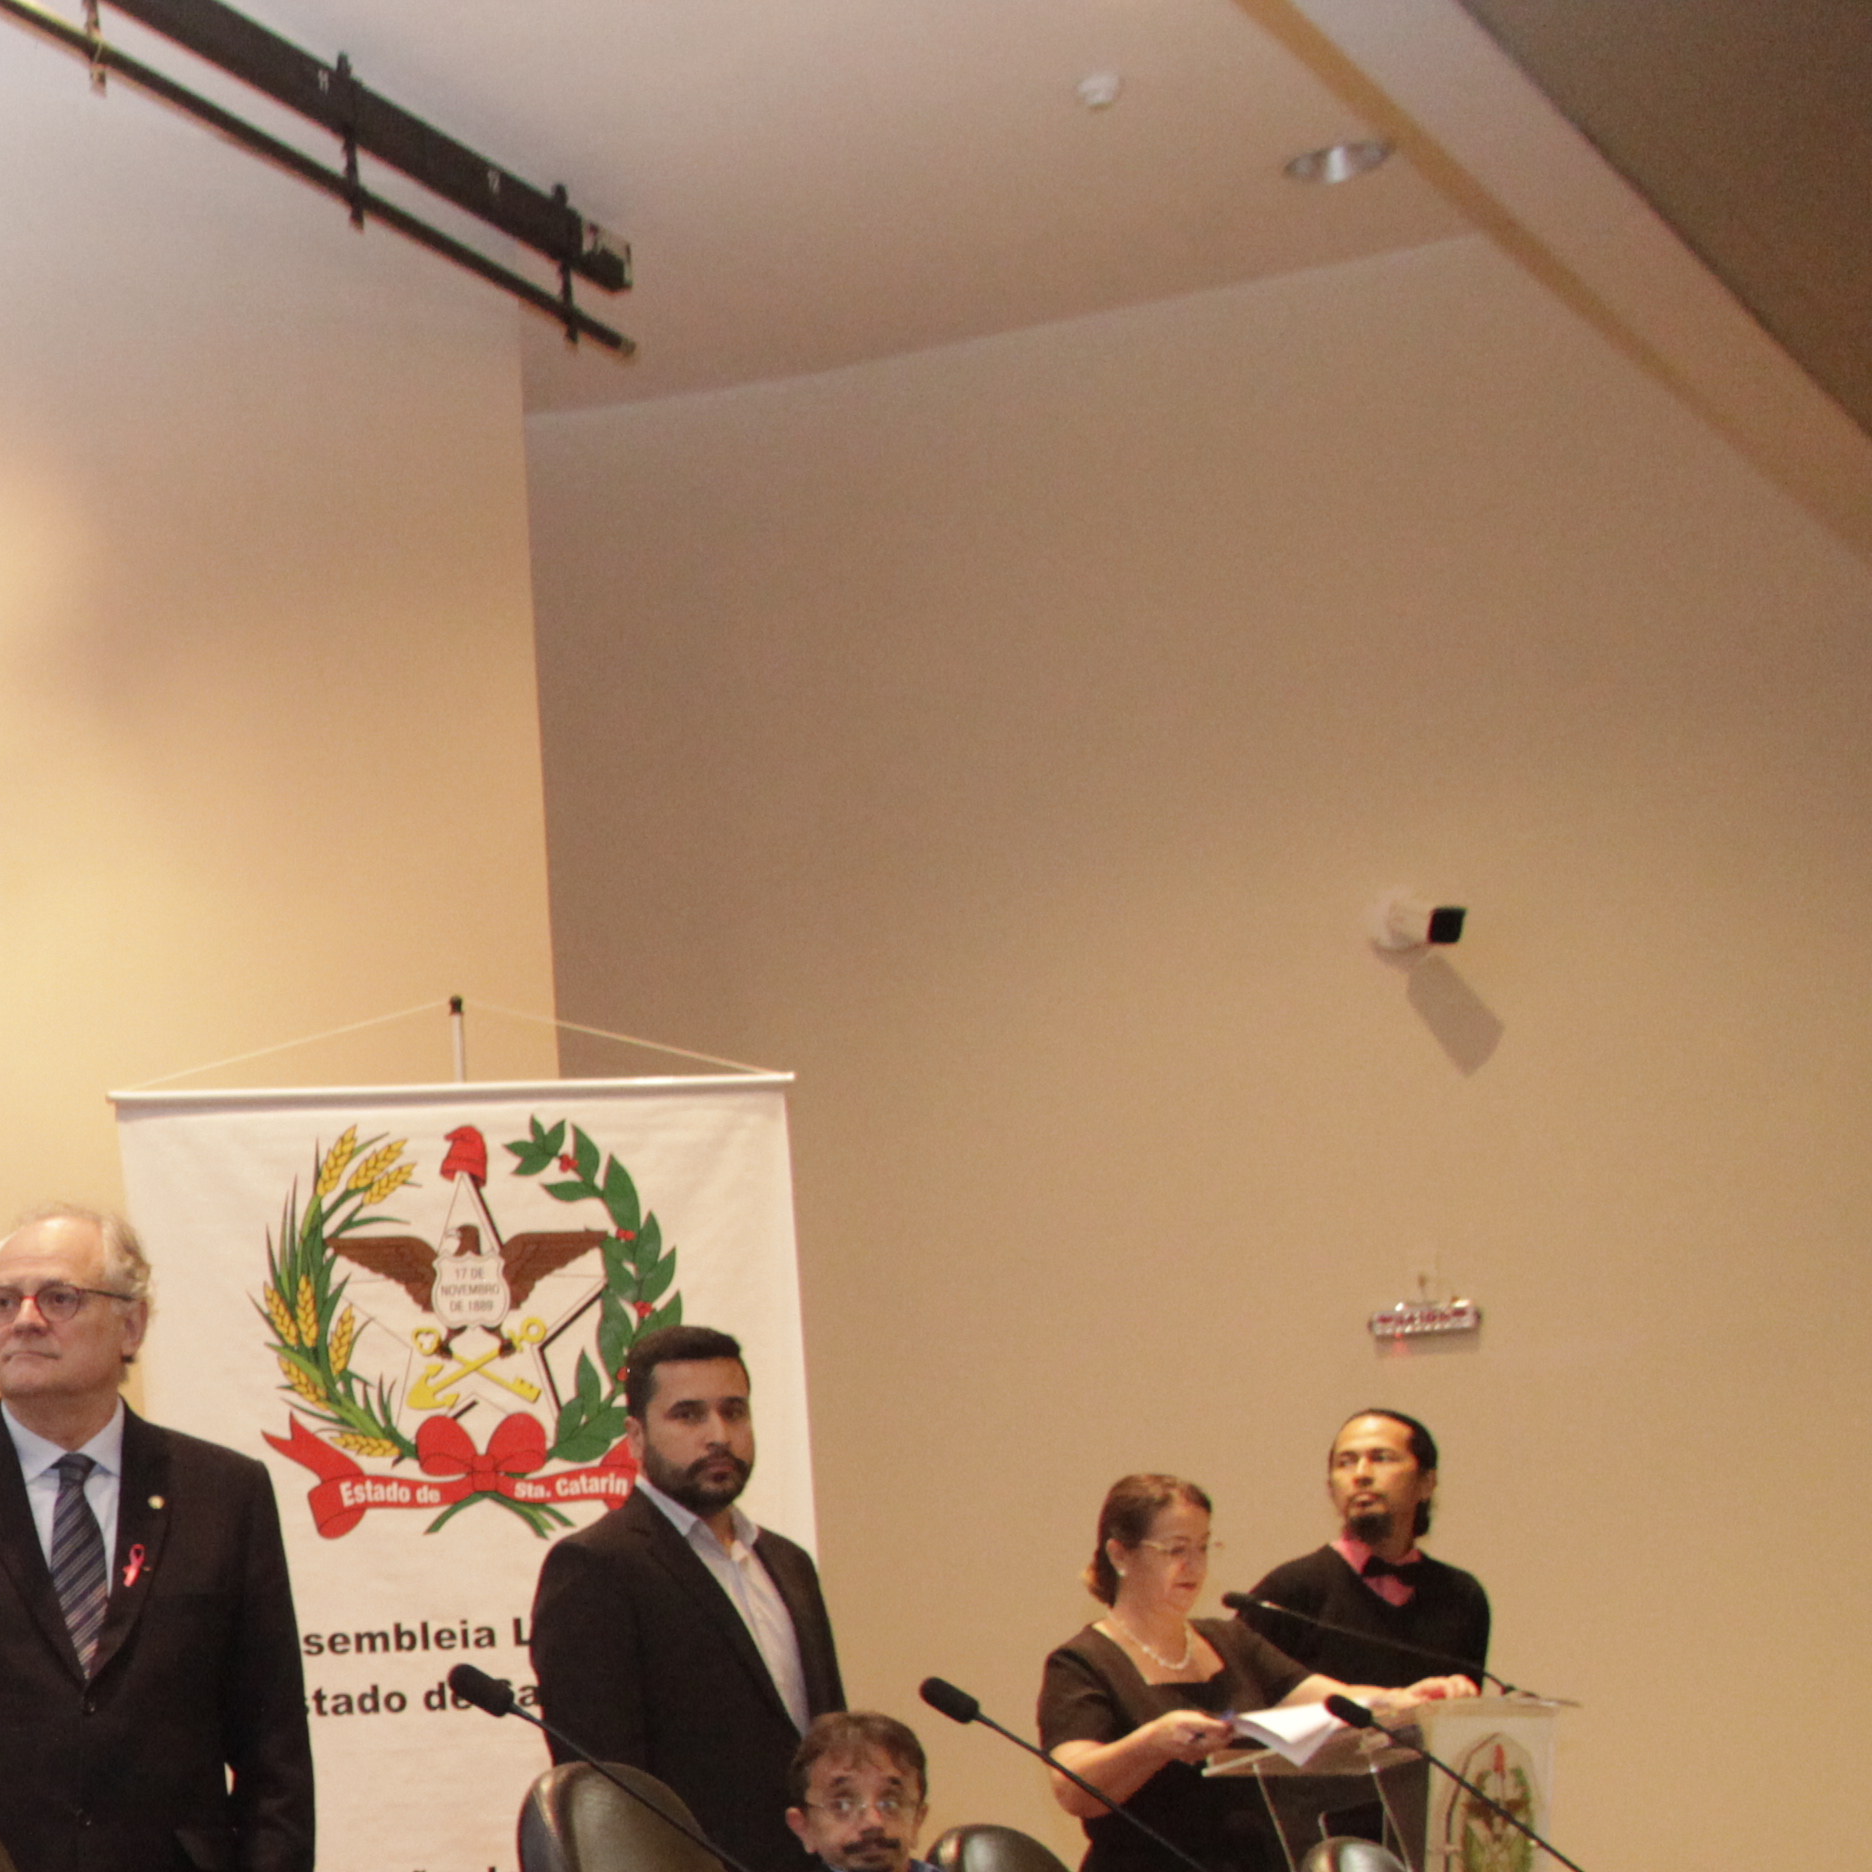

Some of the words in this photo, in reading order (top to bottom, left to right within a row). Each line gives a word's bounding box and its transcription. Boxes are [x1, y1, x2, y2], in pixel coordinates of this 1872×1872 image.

[470, 1268, 484, 1279] DE
[441, 1283, 499, 1297] NOVEMBRO
[450, 1301, 463, 1312] DE
[339, 1479, 411, 1507] Estado
[416, 1485, 441, 1504] de
[514, 1481, 551, 1499] Sta.
[556, 1472, 628, 1497] Catarin
[303, 1619, 496, 1656] sembleia
[308, 1684, 407, 1717] tado
